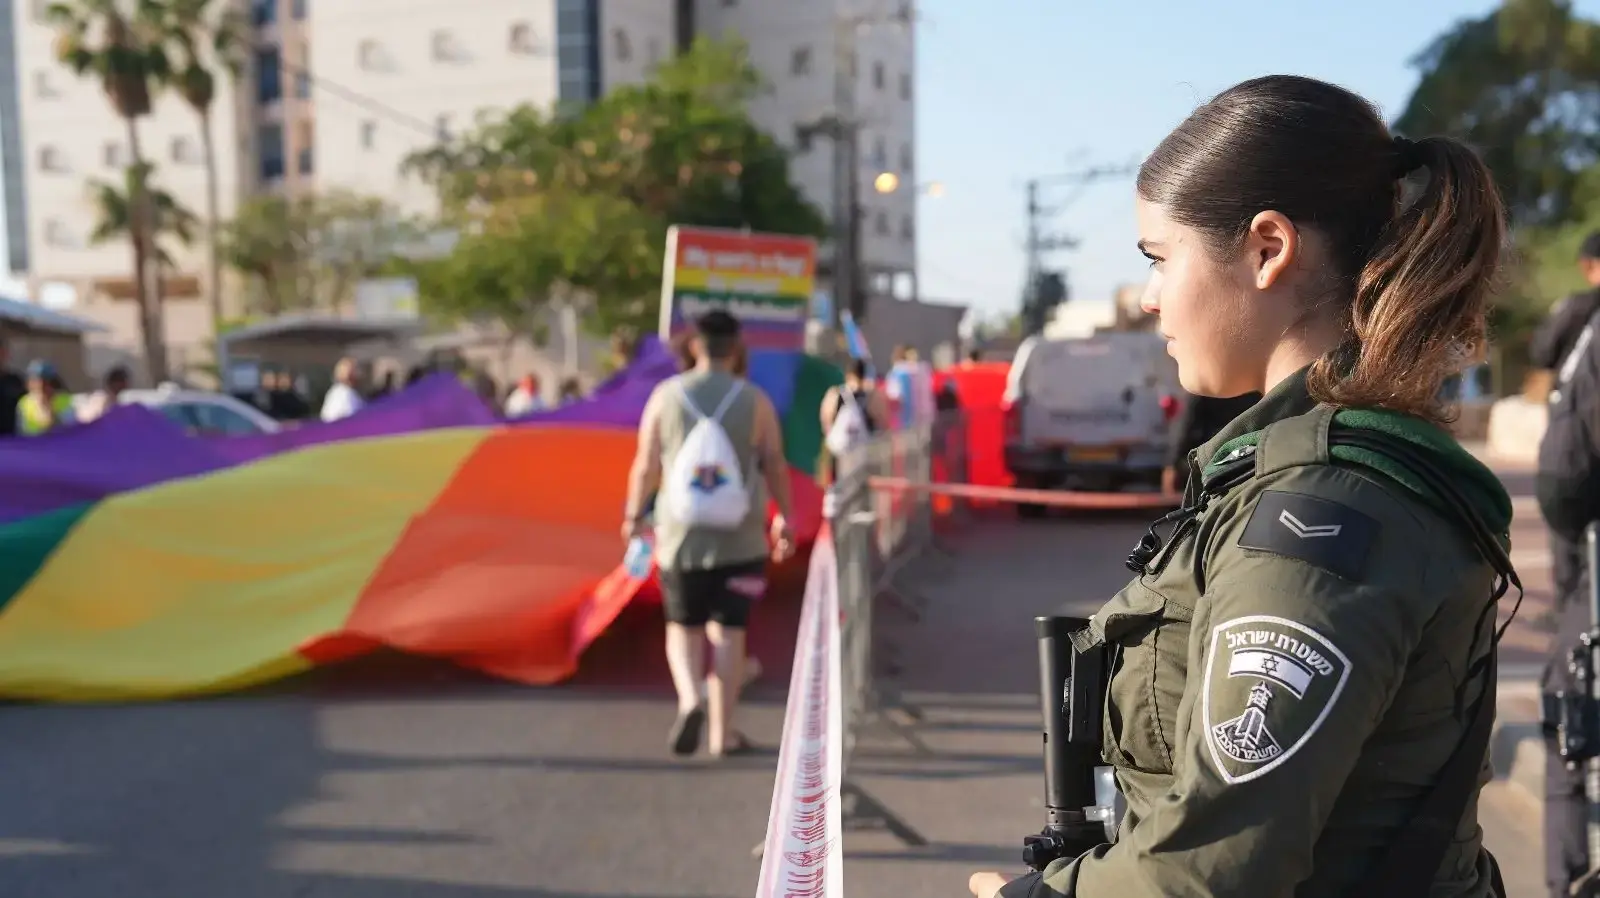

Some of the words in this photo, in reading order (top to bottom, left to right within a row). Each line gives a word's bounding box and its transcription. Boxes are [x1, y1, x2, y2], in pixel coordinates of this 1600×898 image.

[1226, 630, 1275, 649] ישראל
[1275, 634, 1334, 676] משטרת
[1241, 745, 1279, 760] משמר
